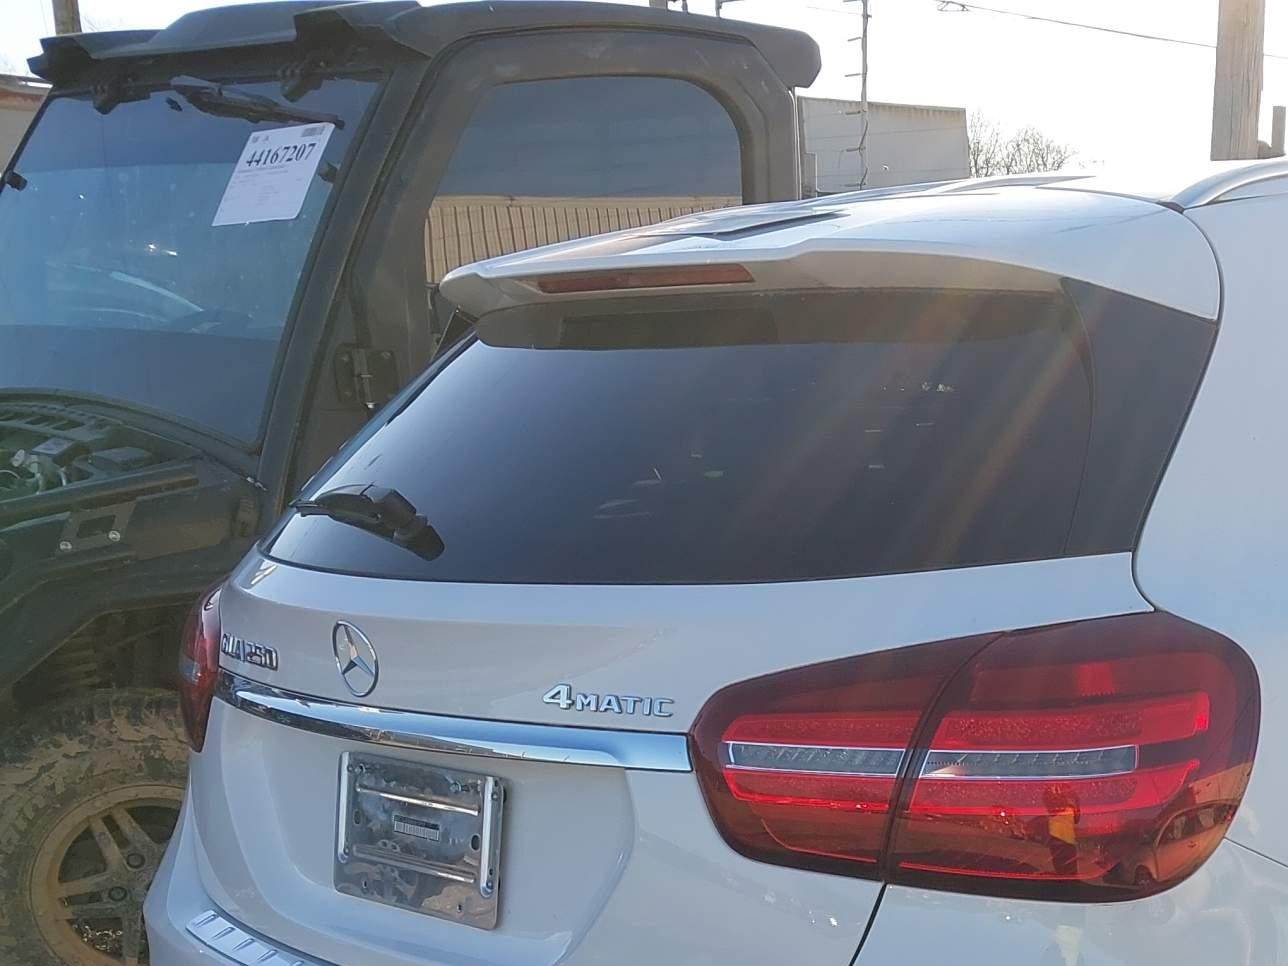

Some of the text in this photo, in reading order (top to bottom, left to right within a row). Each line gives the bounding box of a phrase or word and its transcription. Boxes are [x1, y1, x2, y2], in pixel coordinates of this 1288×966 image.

[246, 142, 317, 167] 44167207
[221, 632, 279, 671] GLA 250
[543, 683, 675, 717] 4MATIC
